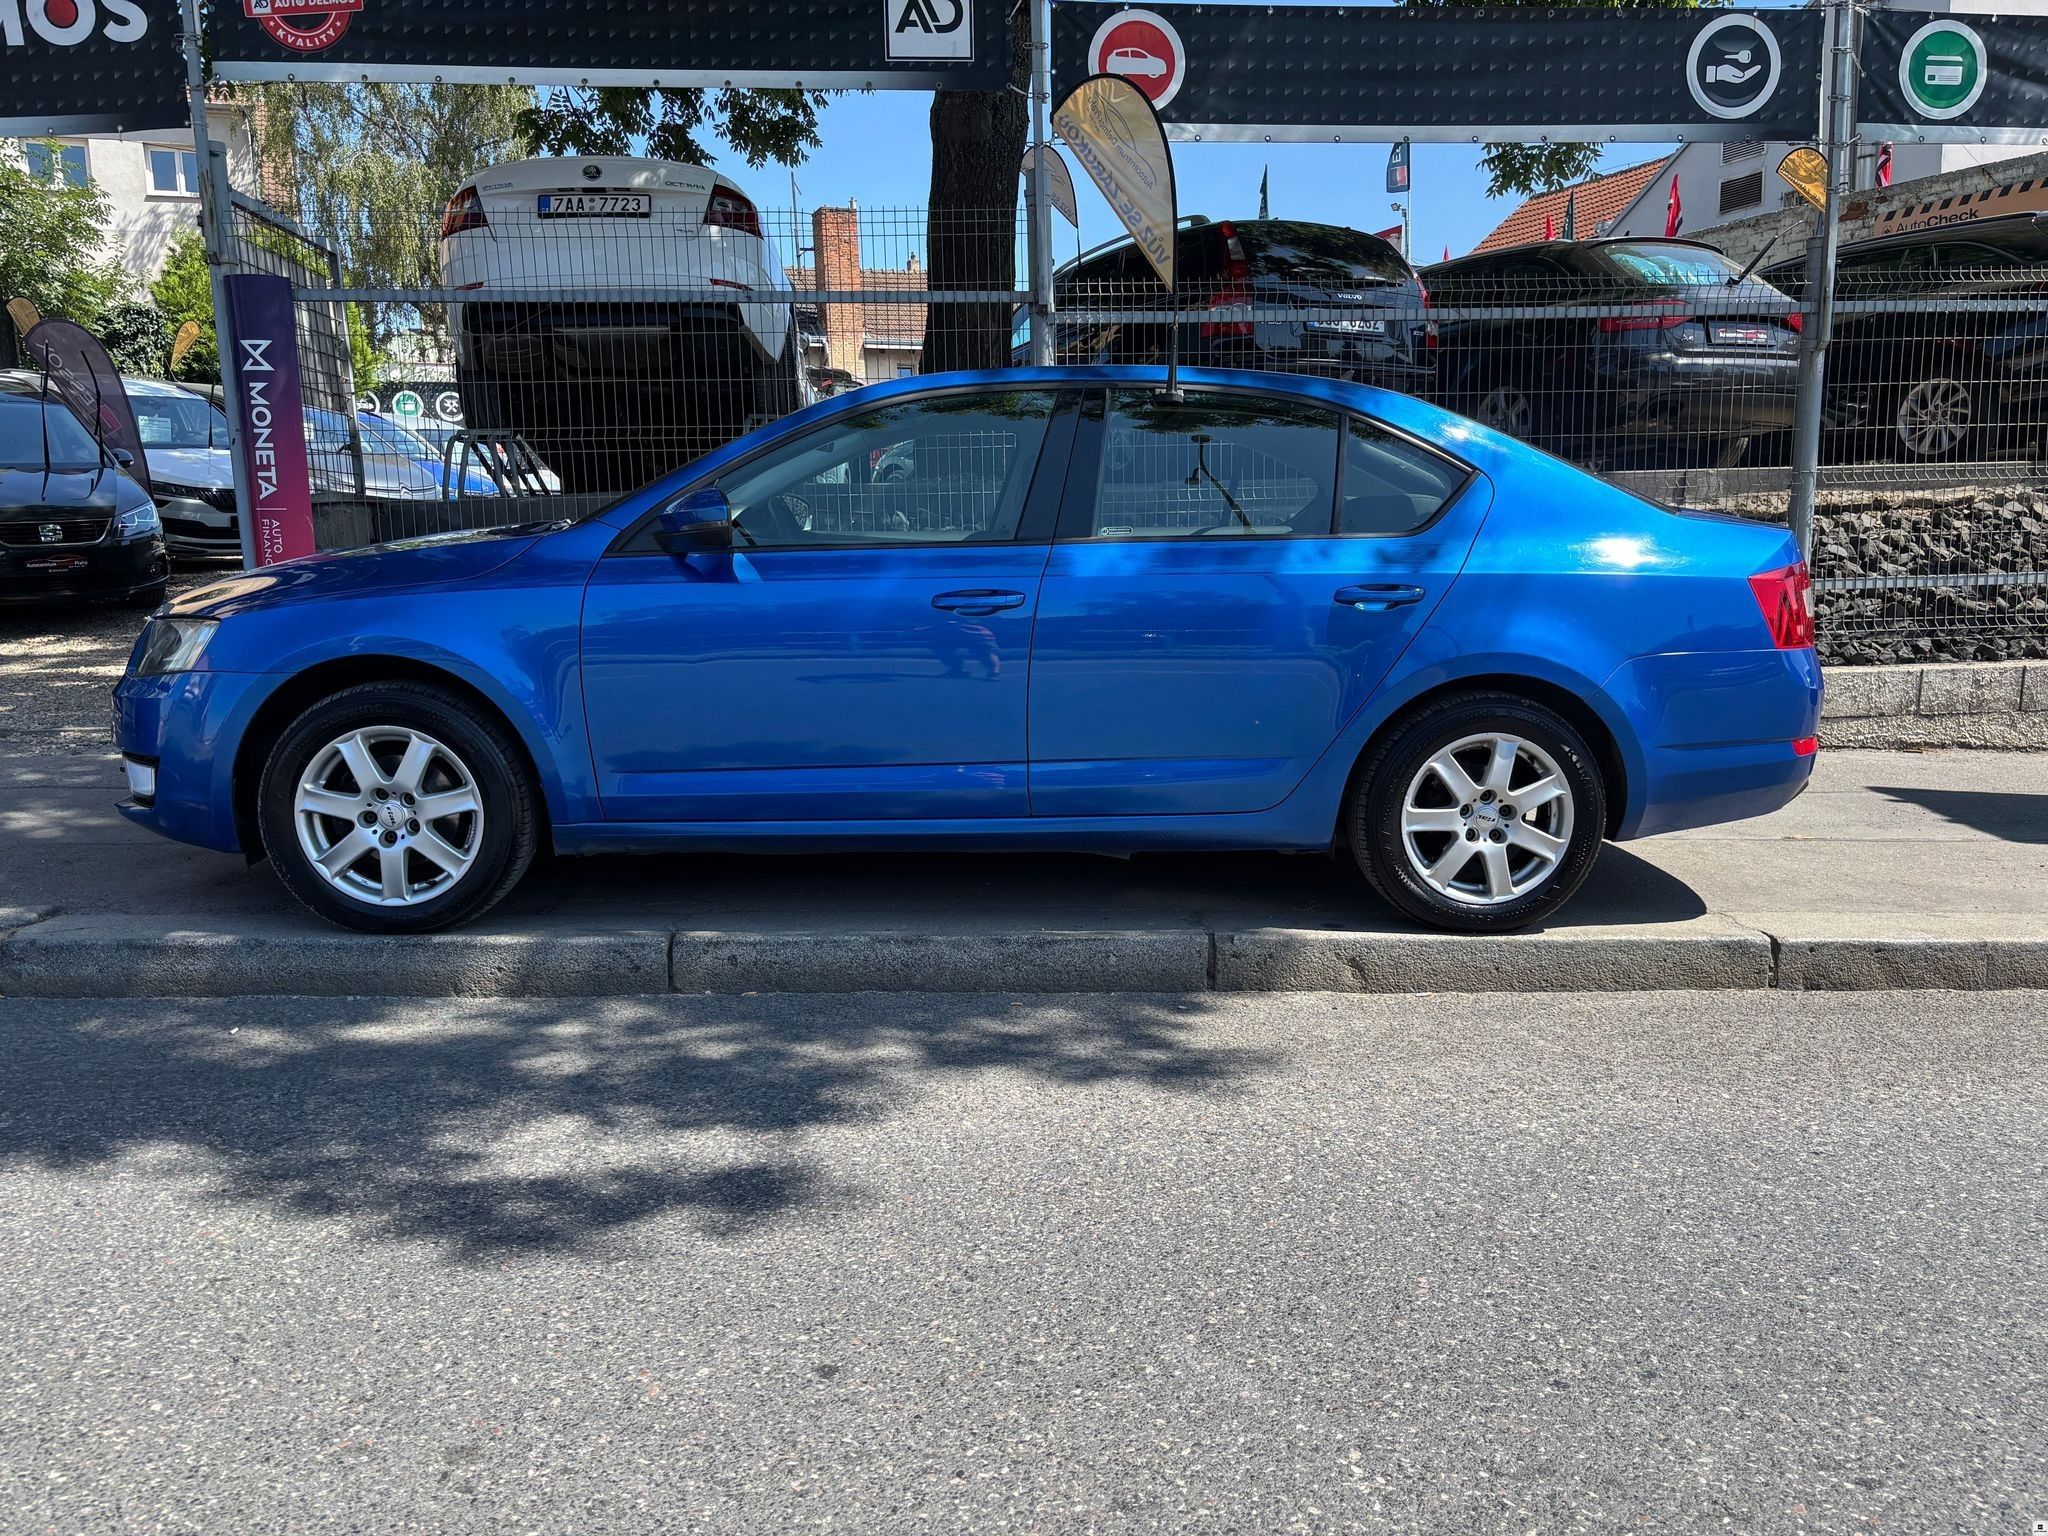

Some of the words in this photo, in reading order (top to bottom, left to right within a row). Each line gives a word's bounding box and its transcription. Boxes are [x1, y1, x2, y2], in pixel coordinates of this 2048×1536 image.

[0, 0, 148, 46] OS
[276, 28, 336, 47] KVALITY
[554, 197, 585, 212] 7AA
[599, 197, 641, 212] 7723
[1896, 208, 1979, 233] AutoCheck
[249, 382, 278, 500] MONETA
[271, 519, 283, 554] AUTO
